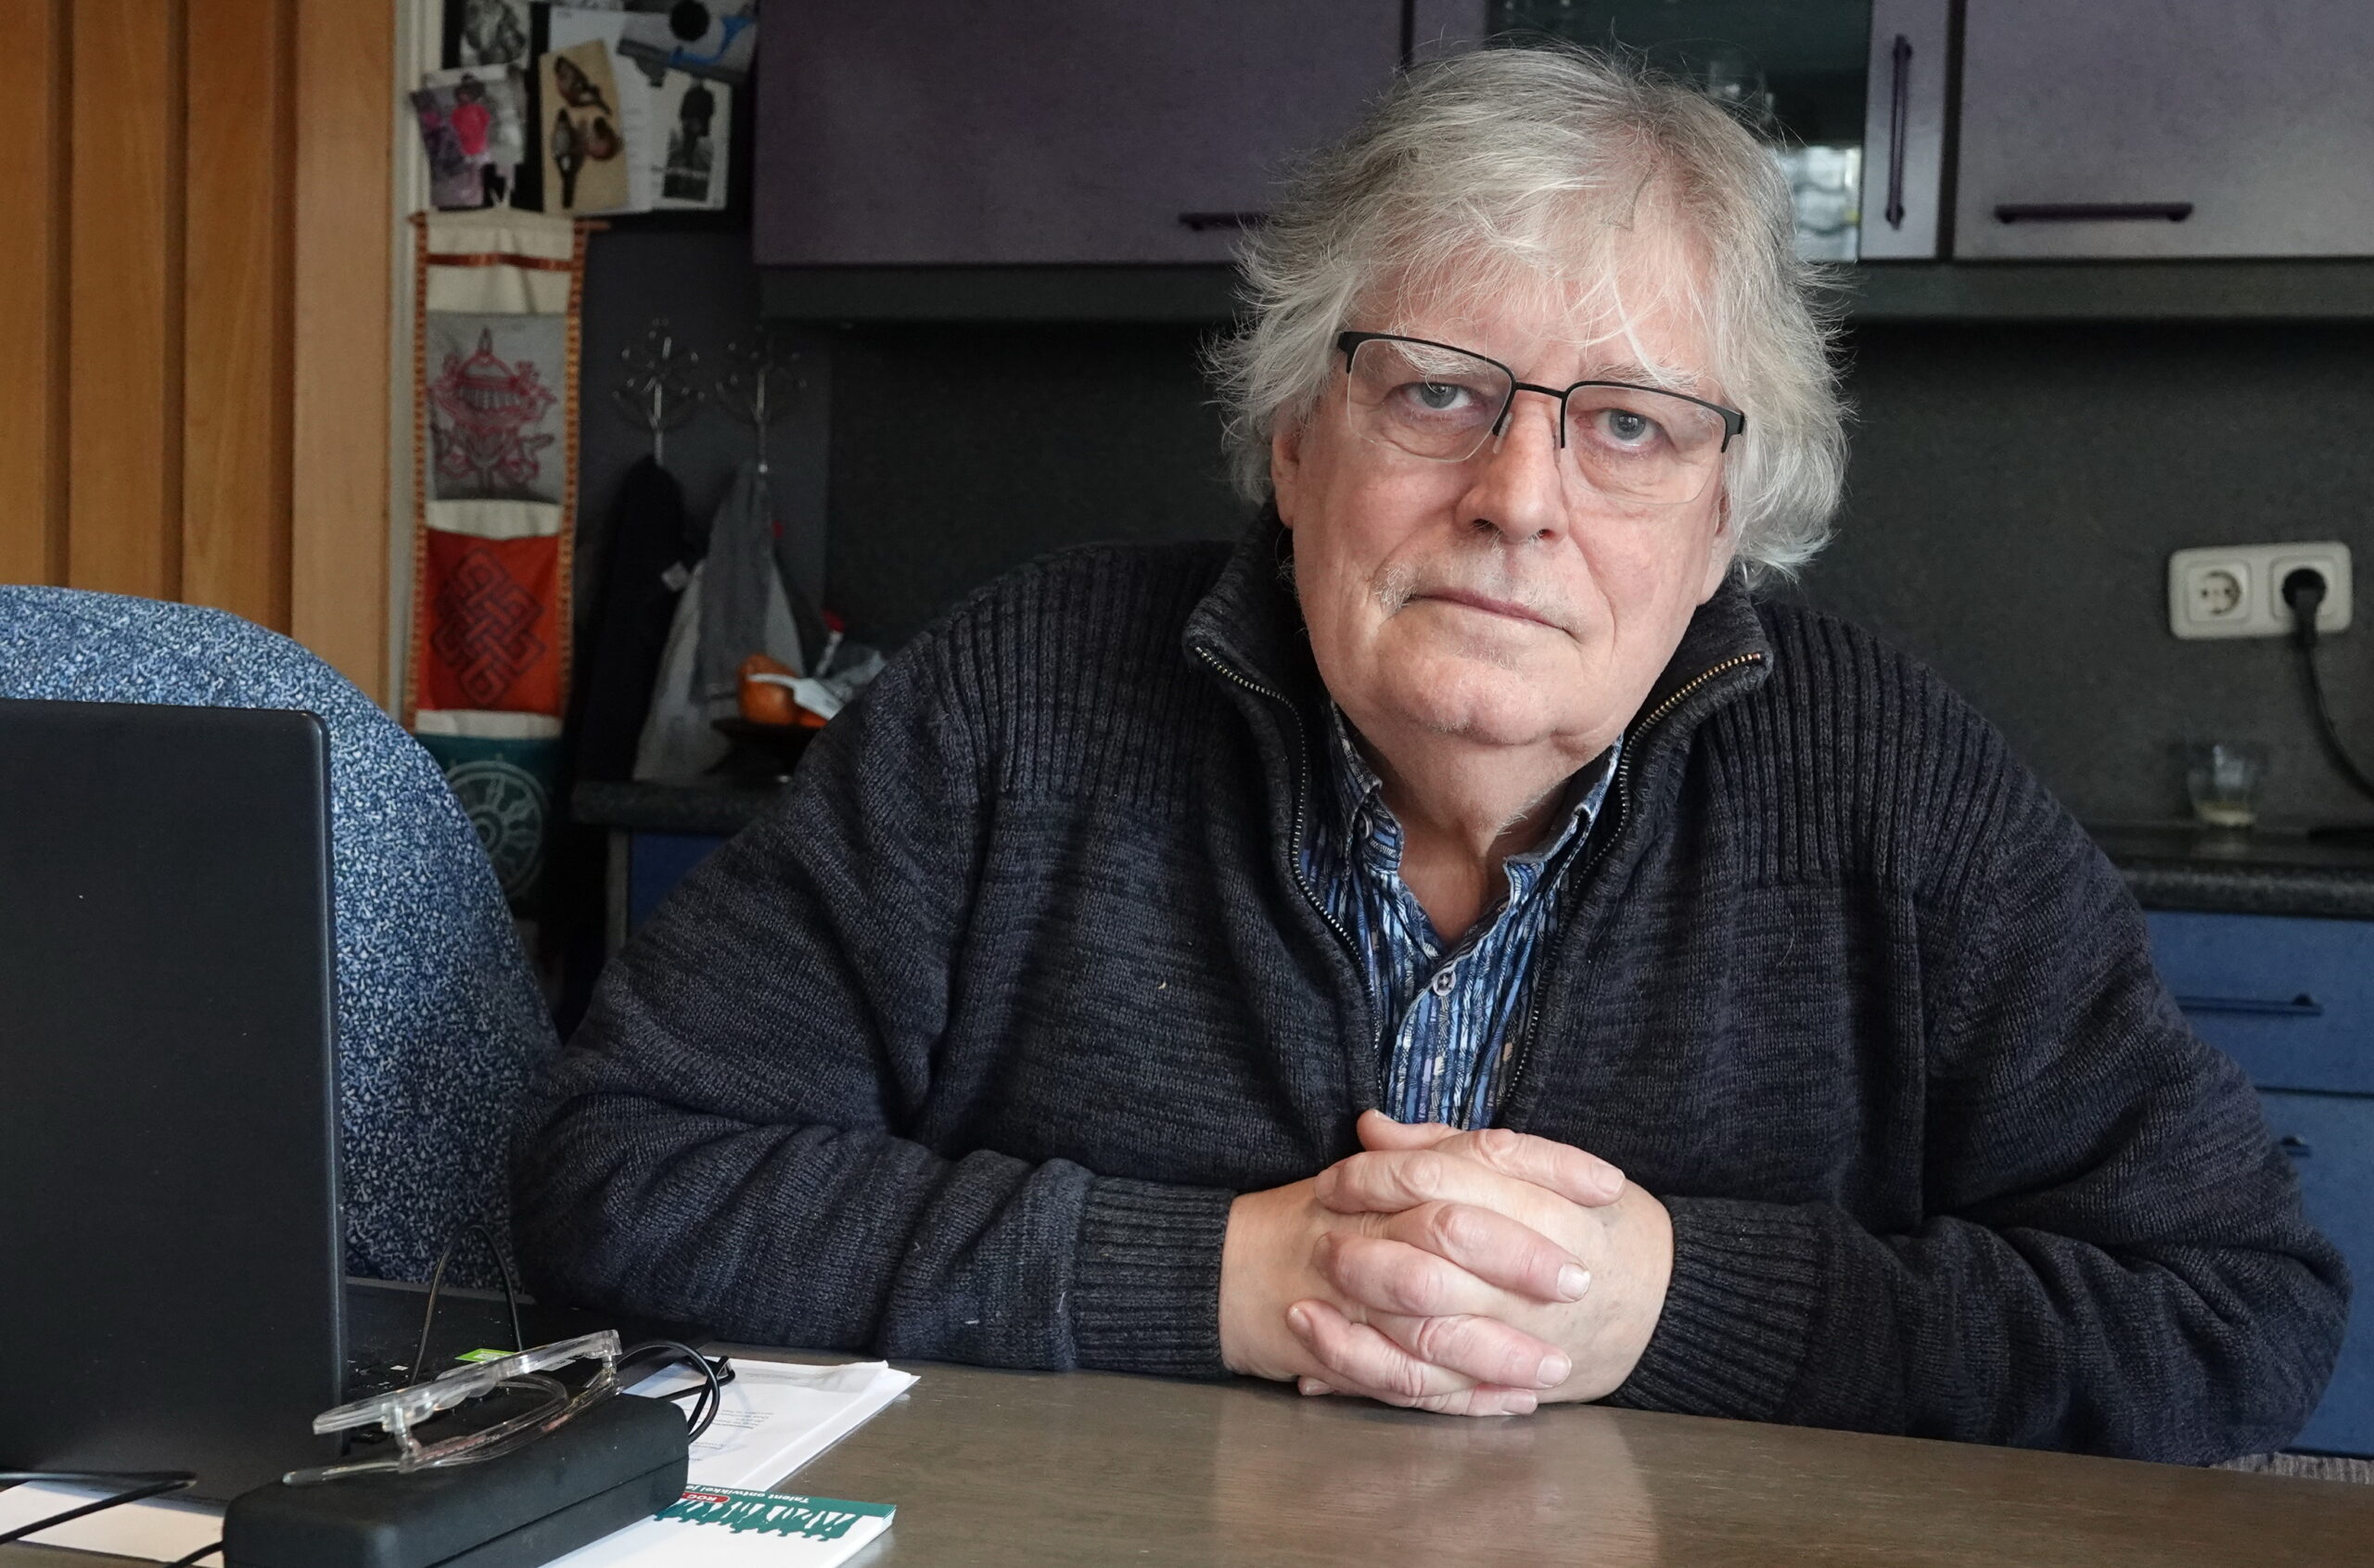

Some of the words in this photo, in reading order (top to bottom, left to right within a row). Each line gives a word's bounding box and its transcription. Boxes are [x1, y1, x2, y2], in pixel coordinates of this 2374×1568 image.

[700, 1486, 766, 1498] ontwikkel
[686, 1494, 718, 1502] ROC
[768, 1493, 810, 1503] Talent
